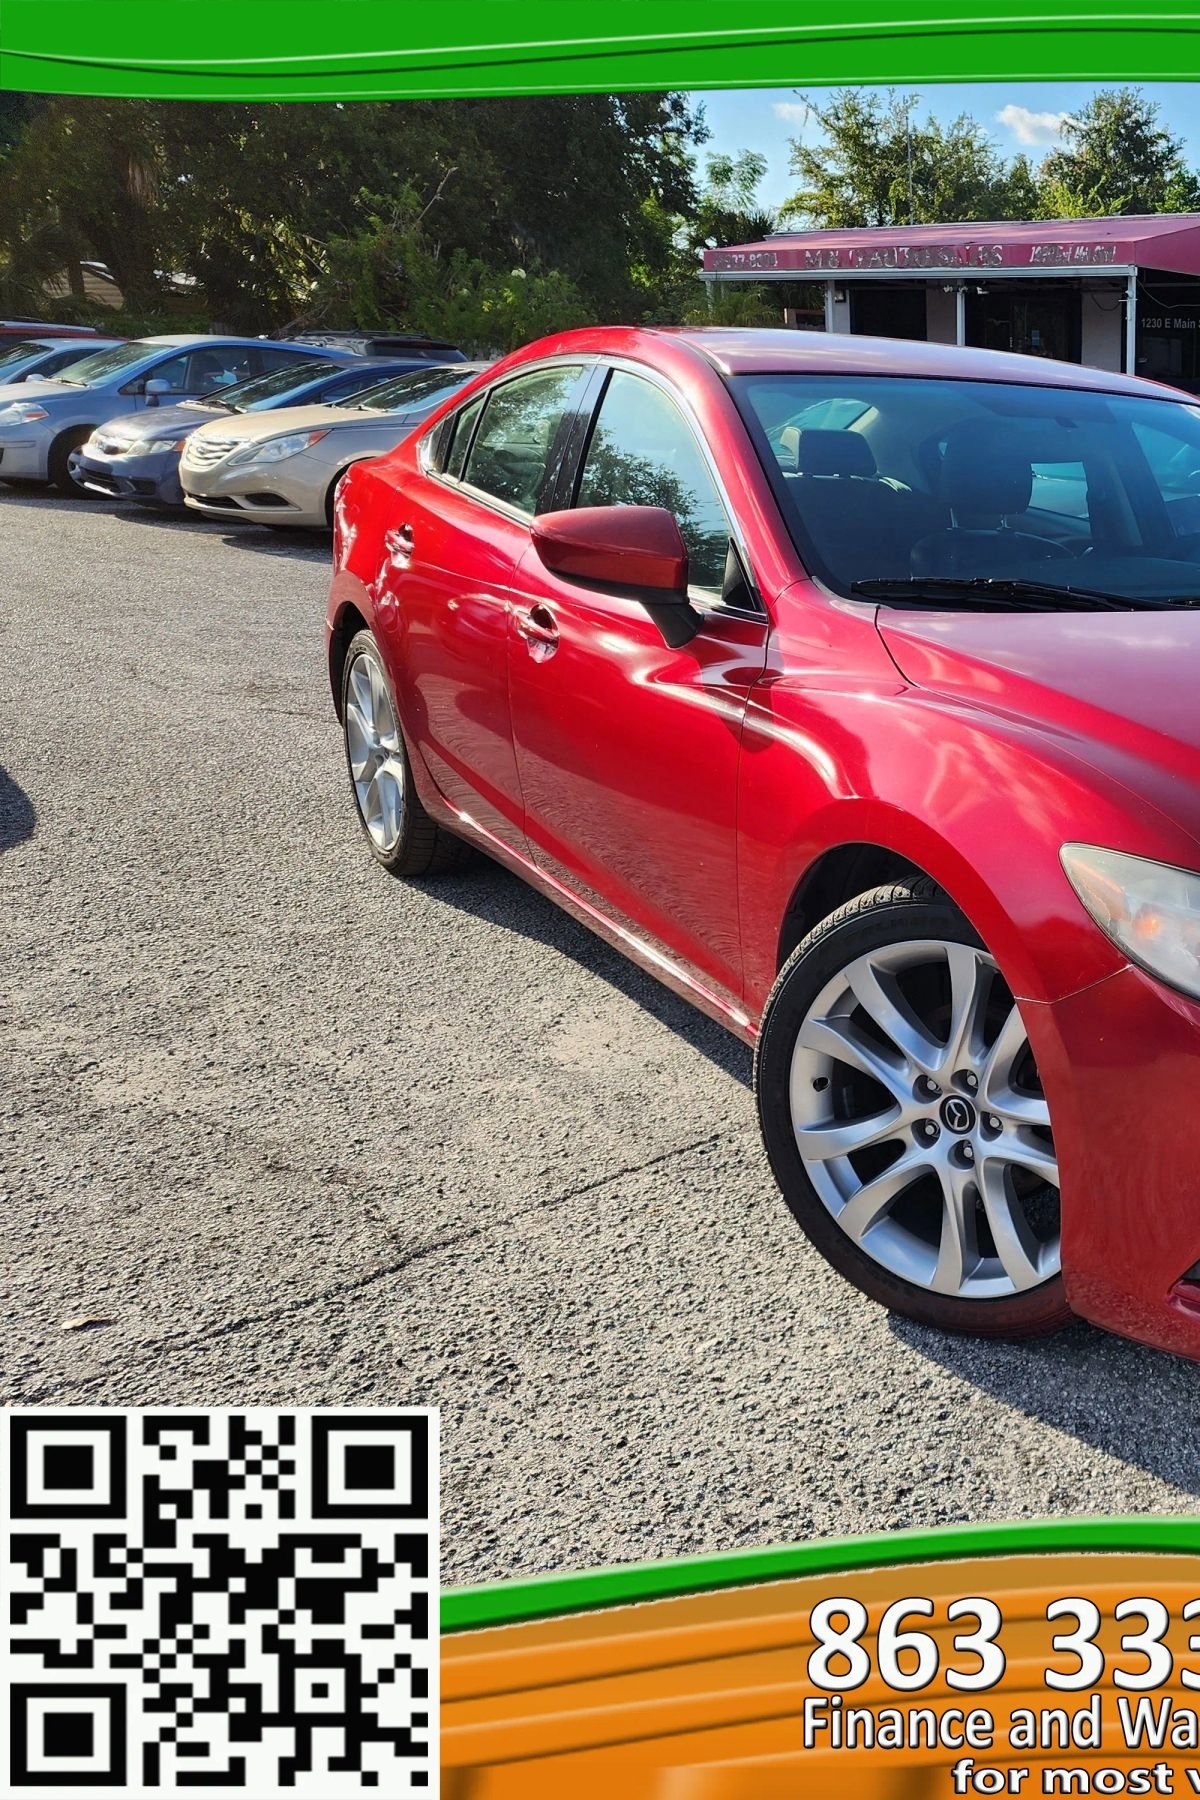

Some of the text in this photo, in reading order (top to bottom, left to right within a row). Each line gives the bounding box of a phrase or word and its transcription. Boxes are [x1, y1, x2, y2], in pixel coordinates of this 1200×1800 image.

[1141, 318, 1162, 328] 1230
[1165, 319, 1171, 329] E
[1174, 318, 1196, 329] Main
